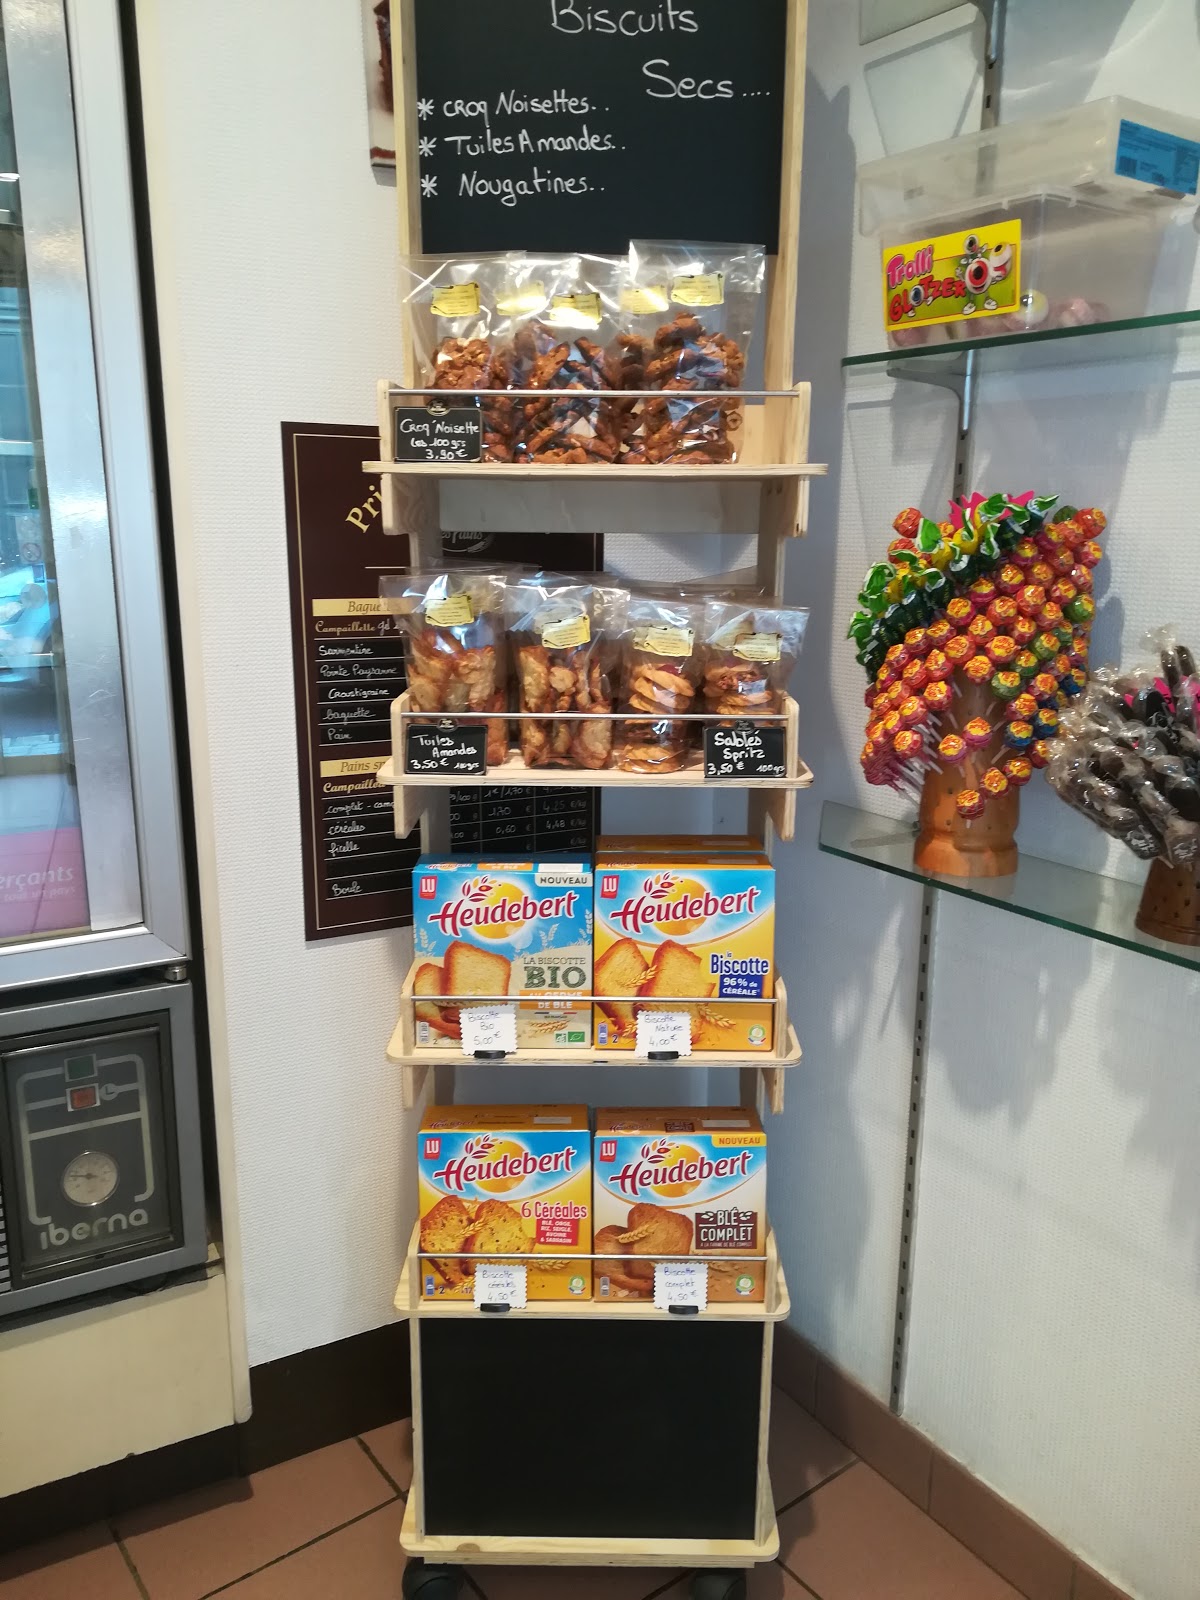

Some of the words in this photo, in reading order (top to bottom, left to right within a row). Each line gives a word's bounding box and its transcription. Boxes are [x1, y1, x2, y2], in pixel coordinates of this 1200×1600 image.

[552, 0, 699, 36] Biscuits
[886, 245, 933, 289] Trolli
[432, 743, 478, 758] Amandes
[340, 761, 371, 773] Pains
[421, 878, 435, 893] LU
[540, 876, 588, 885] NOUVEAU
[603, 878, 616, 893] LU
[429, 891, 579, 937] Heudebert
[610, 887, 760, 933] Heudebert
[523, 957, 536, 965] LA
[537, 957, 586, 965] BISCOTTE
[711, 954, 769, 974] Biscotte
[523, 966, 587, 988] BIO
[611, 1034, 619, 1044] 2
[426, 1140, 439, 1154] LU
[602, 1142, 615, 1156] LU
[718, 1137, 761, 1145] NOUVEAU
[434, 1147, 576, 1191] Heudebert
[609, 1151, 752, 1196] Heudebert
[521, 1201, 532, 1218] 6
[535, 1200, 588, 1218] Céréales
[717, 1207, 739, 1226] BLÉ
[40, 1208, 149, 1250] iberna
[700, 1227, 753, 1242] COMPLET
